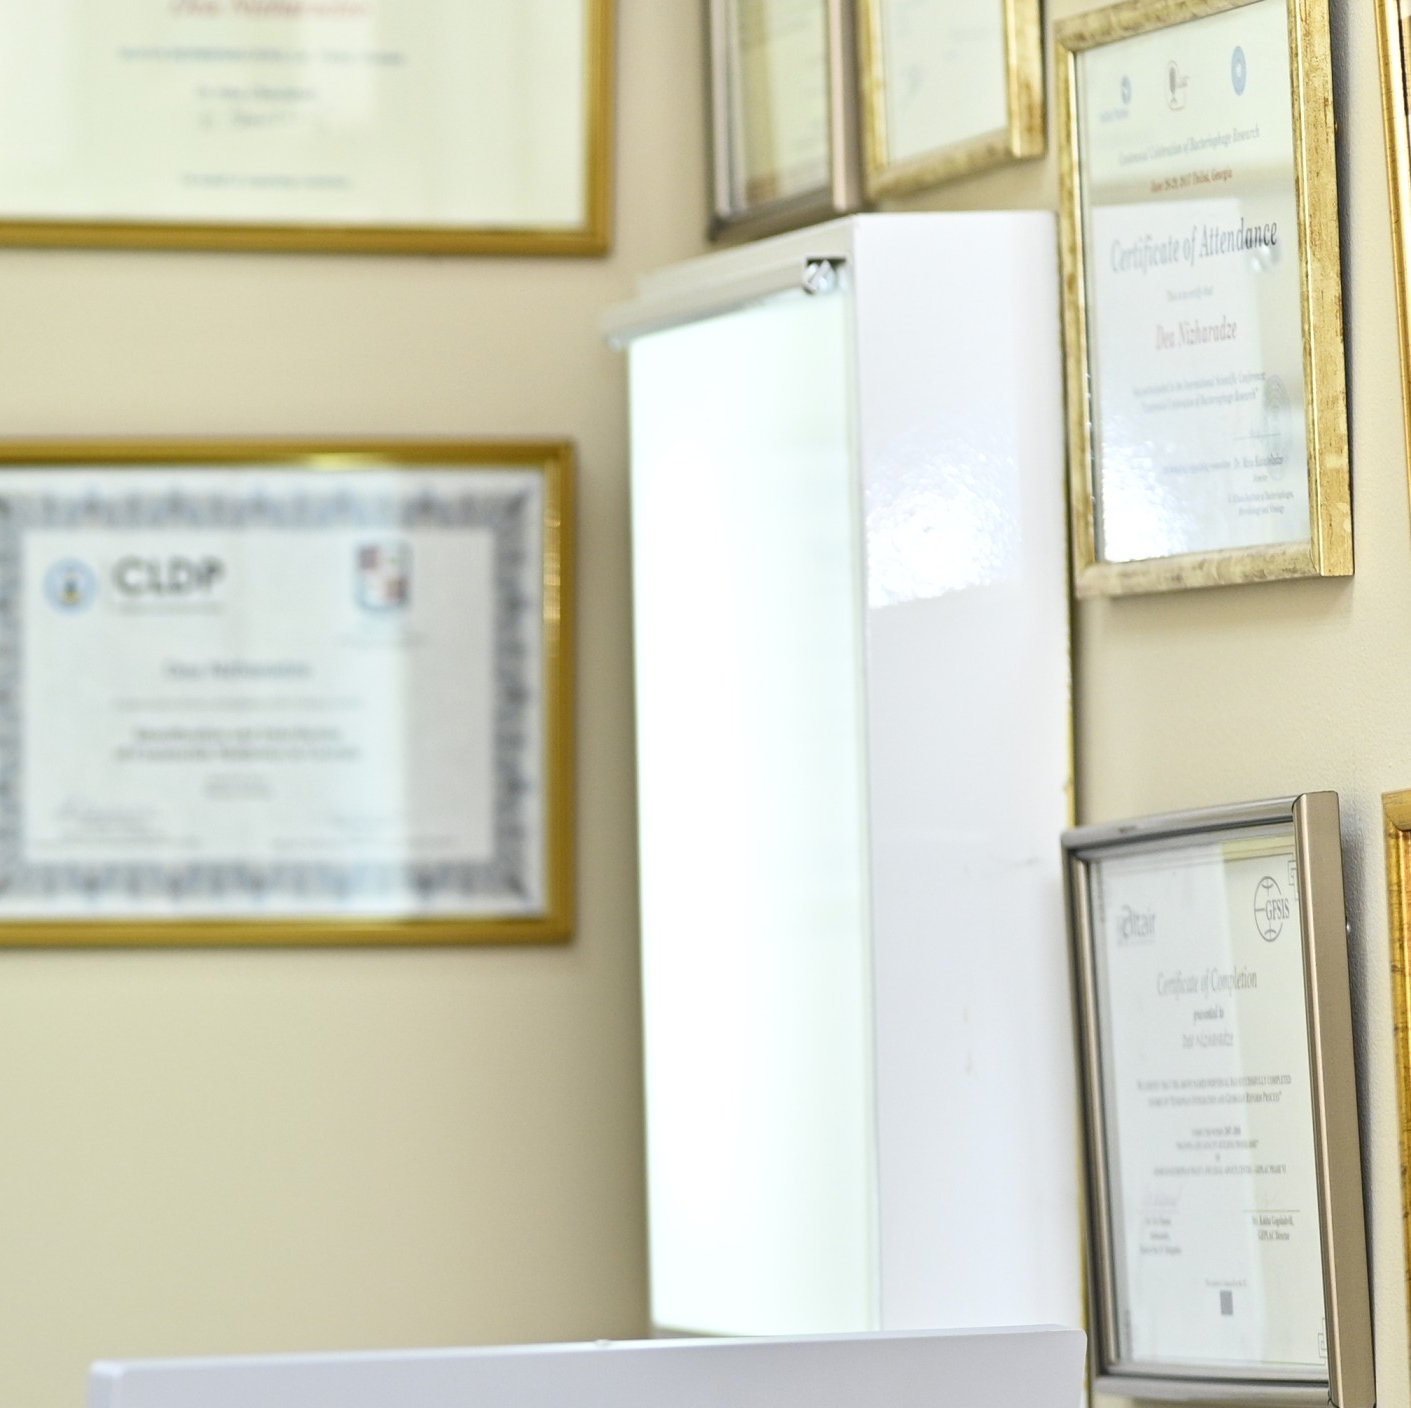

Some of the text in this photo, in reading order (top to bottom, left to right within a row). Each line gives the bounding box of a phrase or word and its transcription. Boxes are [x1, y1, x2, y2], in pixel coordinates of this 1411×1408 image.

[1110, 217, 1278, 274] Certificate of Attendance
[112, 556, 225, 595] CLDP
[1265, 897, 1290, 921] GFSIS
